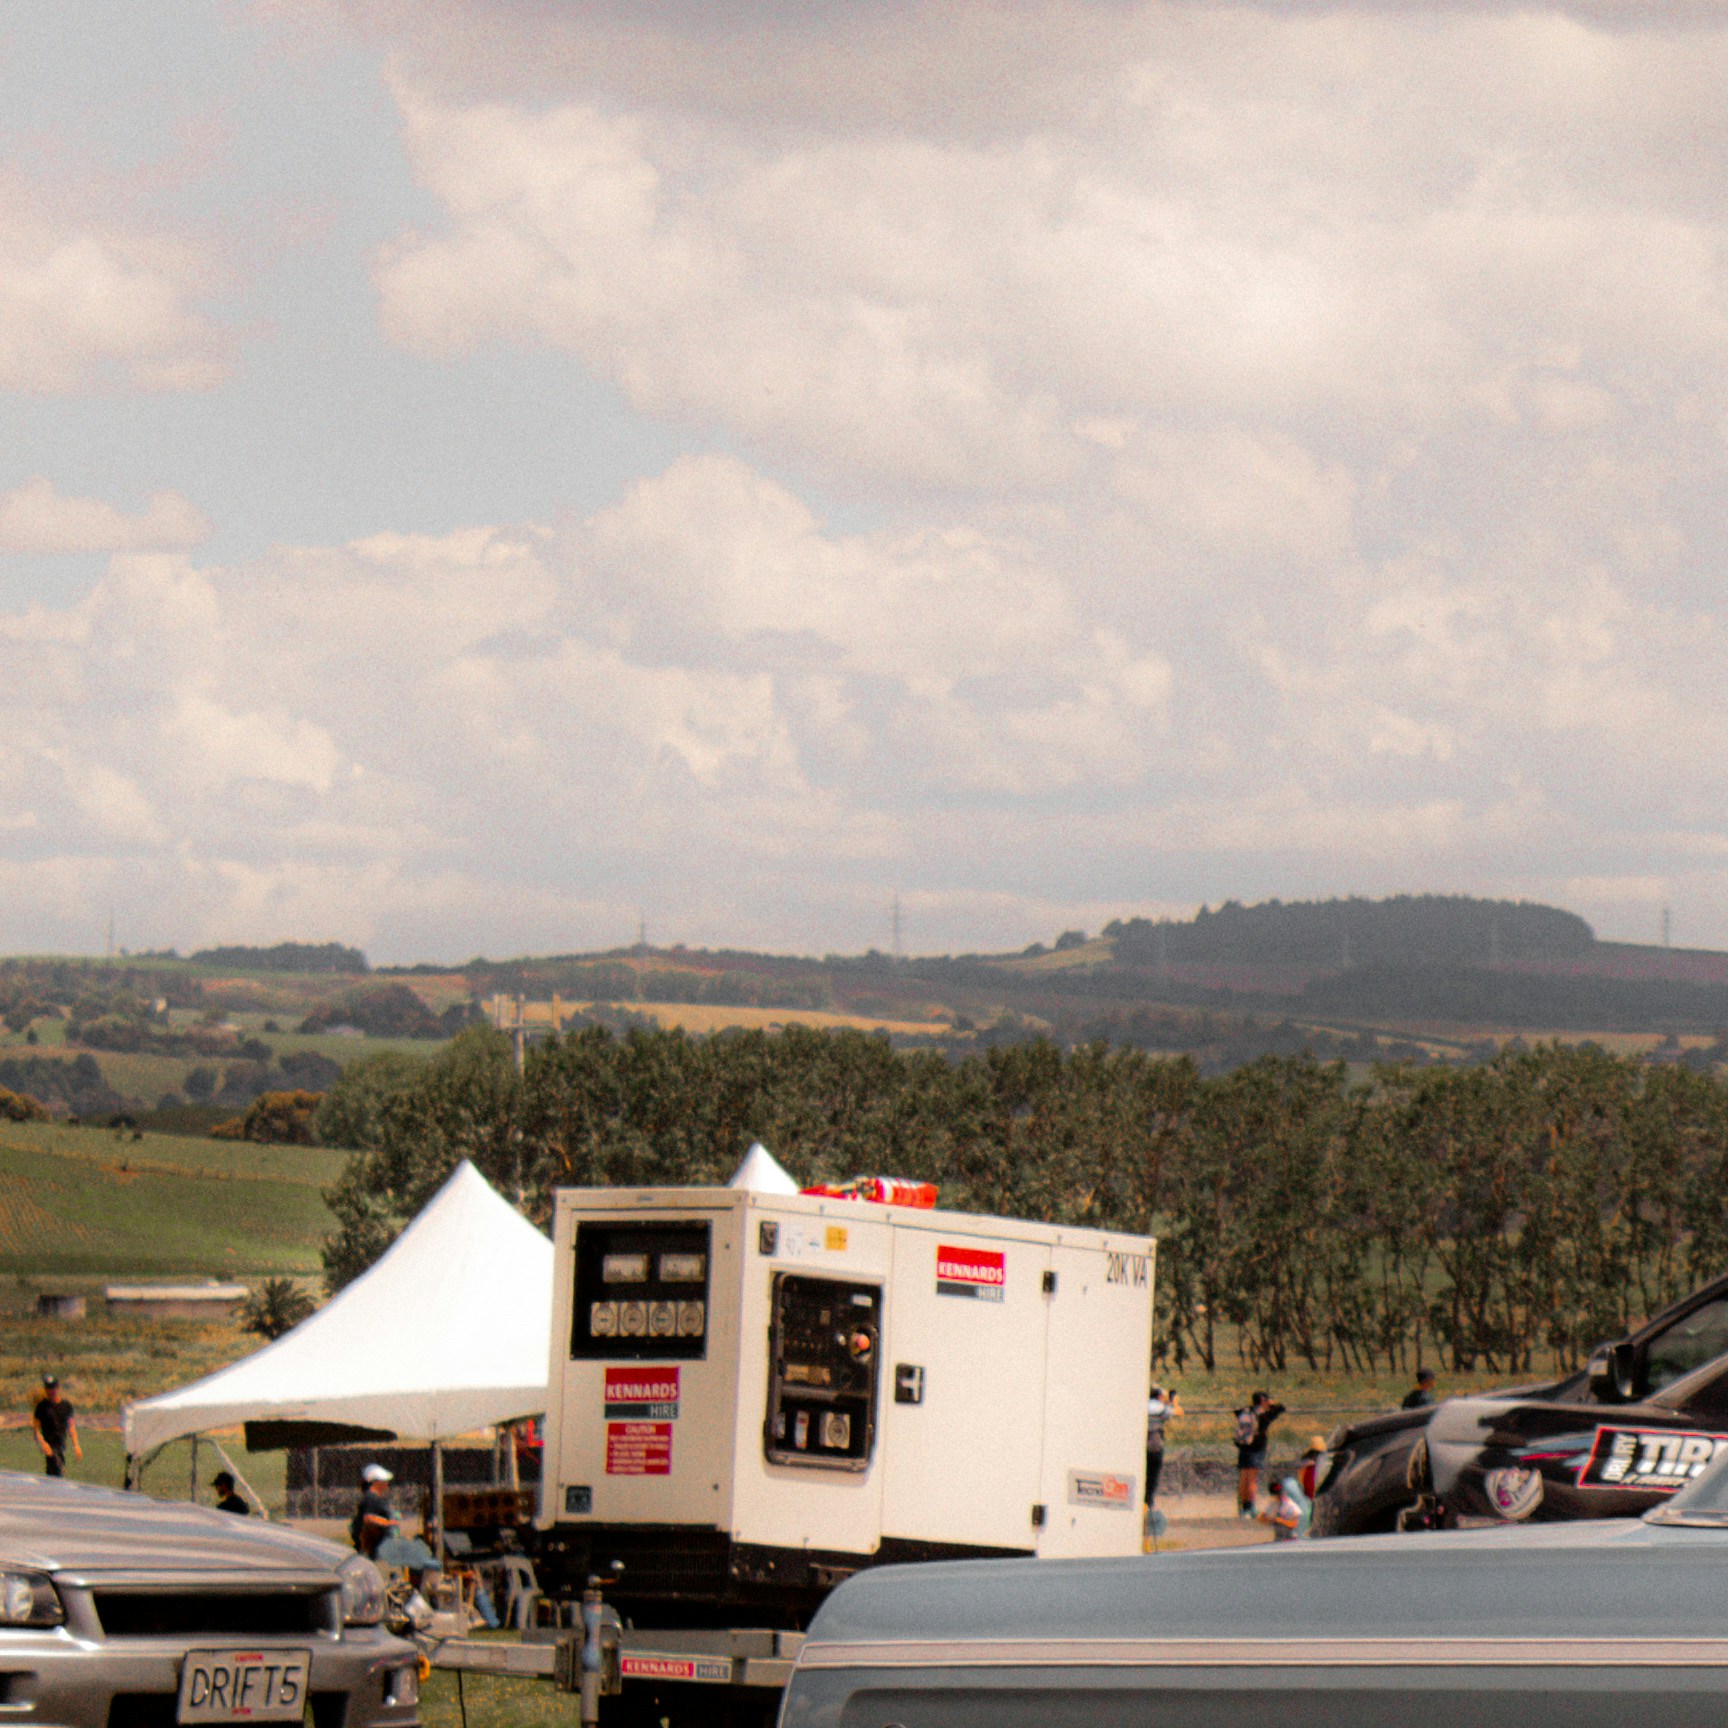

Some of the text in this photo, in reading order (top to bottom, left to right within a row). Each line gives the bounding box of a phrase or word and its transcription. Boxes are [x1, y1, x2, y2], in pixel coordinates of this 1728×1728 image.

[938, 1261, 1004, 1283] KENNARDS
[978, 1286, 1004, 1301] HIRE
[606, 1383, 678, 1399] KENNARDS
[650, 1404, 677, 1418] HIRE
[626, 1660, 726, 1677] KENNARDS HIRE
[190, 1665, 302, 1708] DRIFT5
